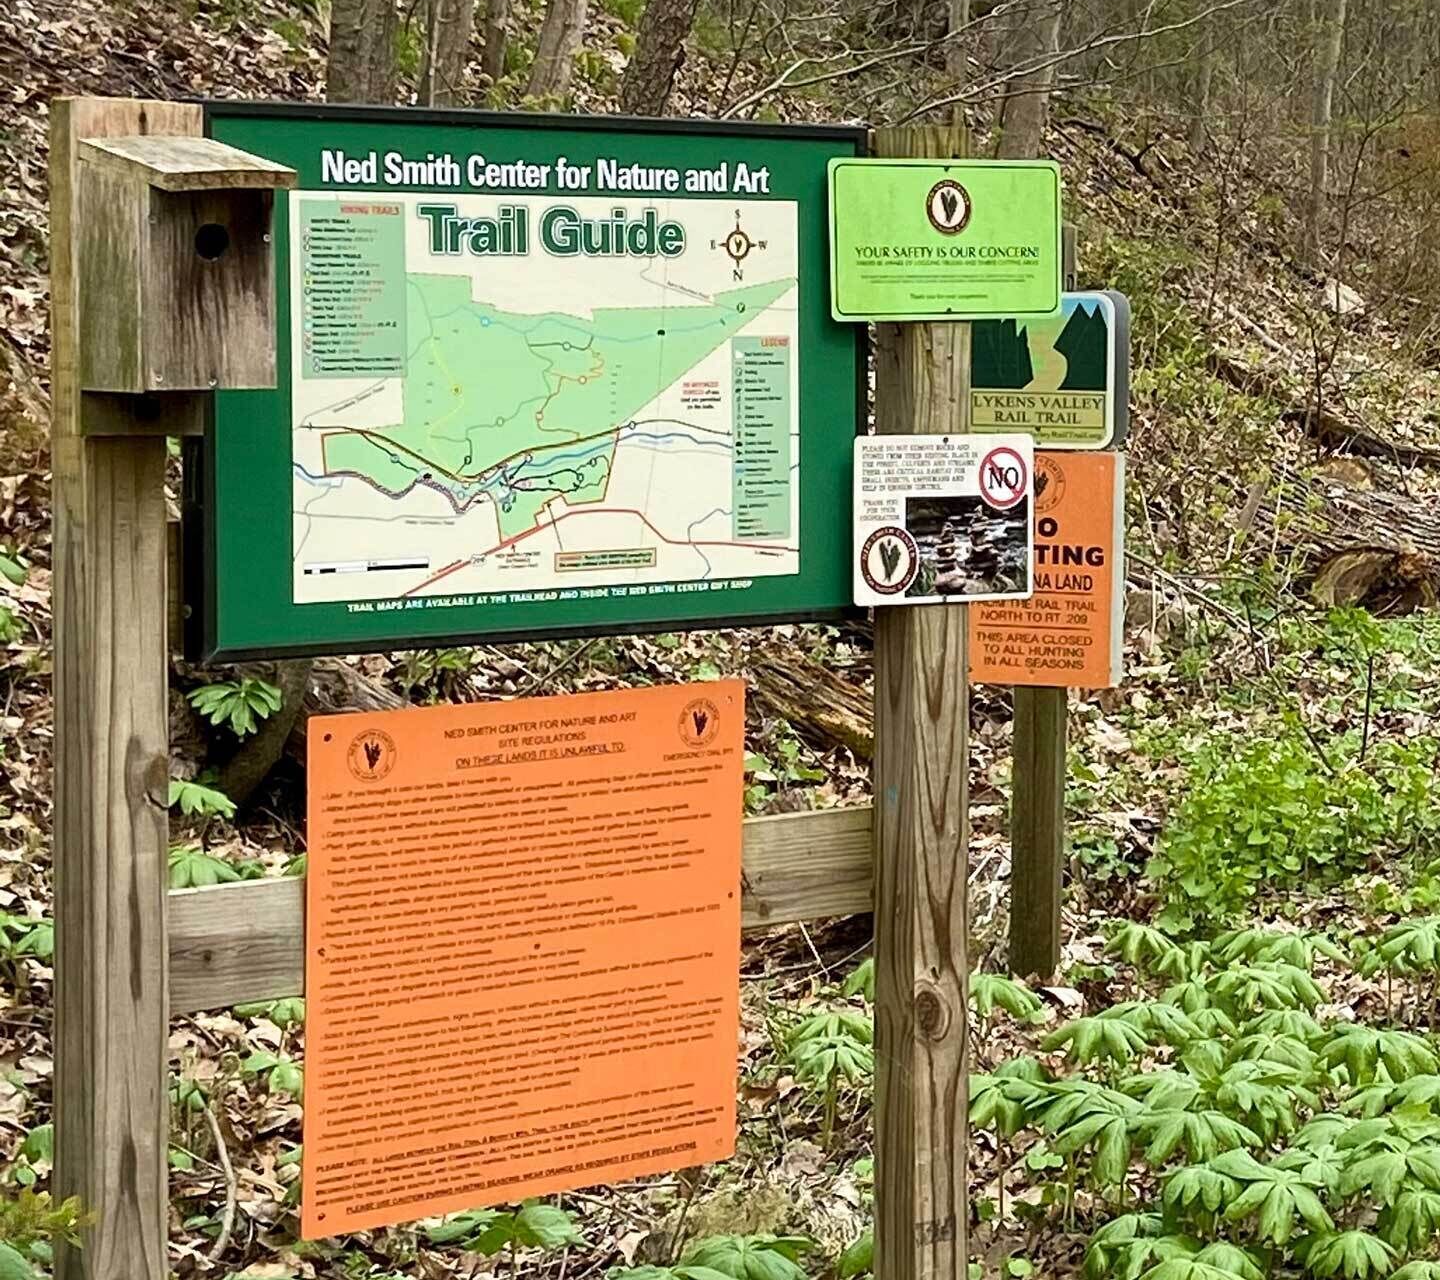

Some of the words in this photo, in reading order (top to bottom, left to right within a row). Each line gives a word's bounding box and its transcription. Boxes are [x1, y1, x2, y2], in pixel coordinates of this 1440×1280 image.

[322, 150, 377, 183] Ned
[384, 152, 460, 186] Smith
[468, 155, 550, 188] Center
[555, 157, 591, 189] for
[597, 159, 680, 191] Nature
[685, 162, 727, 193] and
[733, 163, 770, 194] Art
[734, 209, 741, 220] S
[418, 203, 528, 256] Trail
[540, 206, 686, 257] Guide
[758, 240, 768, 250] W
[855, 246, 890, 258] YOUR
[893, 246, 933, 258] SAFETY
[936, 246, 947, 258] IS
[950, 246, 976, 258] OUR
[978, 246, 1040, 258] CONCERN!
[733, 269, 743, 281] N
[974, 396, 1036, 408] LYKENS
[1039, 397, 1103, 410] VALLEY
[994, 411, 1031, 423] RAIL
[1035, 411, 1081, 425] TRAIL
[988, 467, 1019, 490] NO
[1034, 517, 1058, 537] O
[1034, 544, 1105, 567] TING
[1055, 575, 1093, 591] LAND
[347, 604, 374, 613] TRAIL
[376, 601, 403, 611] MAPS
[405, 599, 424, 609] ARE
[426, 597, 474, 608] AVAILABLE
[476, 596, 488, 605] AT
[509, 593, 558, 602] TRAILHEAD
[559, 591, 578, 600] AND
[1010, 599, 1031, 609] THE
[1035, 599, 1061, 611] RAIL
[1065, 600, 1097, 612] TRAIL
[980, 610, 1023, 621] NORTH
[1025, 611, 1042, 622] TO
[1065, 613, 1088, 625] 209
[977, 631, 1003, 642] THIS
[1006, 633, 1039, 644] AREA
[1042, 634, 1093, 646] CLOSED
[984, 643, 1000, 654] TO
[1002, 644, 1025, 655] ALL
[1028, 646, 1084, 658] HUNTING
[984, 655, 996, 666] IN
[999, 656, 1021, 667] ALL
[1025, 658, 1084, 670] SEASONS
[444, 727, 465, 739] NED
[466, 725, 497, 737] SMITH
[498, 721, 537, 735] CENTER
[539, 719, 559, 730] FOR
[561, 715, 596, 728] NATURE
[599, 713, 618, 724] AND
[619, 712, 637, 722] ART
[498, 735, 520, 748] SITE
[521, 731, 586, 746] REGULATIONS
[456, 757, 471, 768] ON
[473, 754, 503, 766] THESE
[505, 751, 537, 764] LANDS
[539, 749, 548, 760] IT
[550, 749, 559, 759] IS
[560, 744, 609, 757] UNLAWFUL
